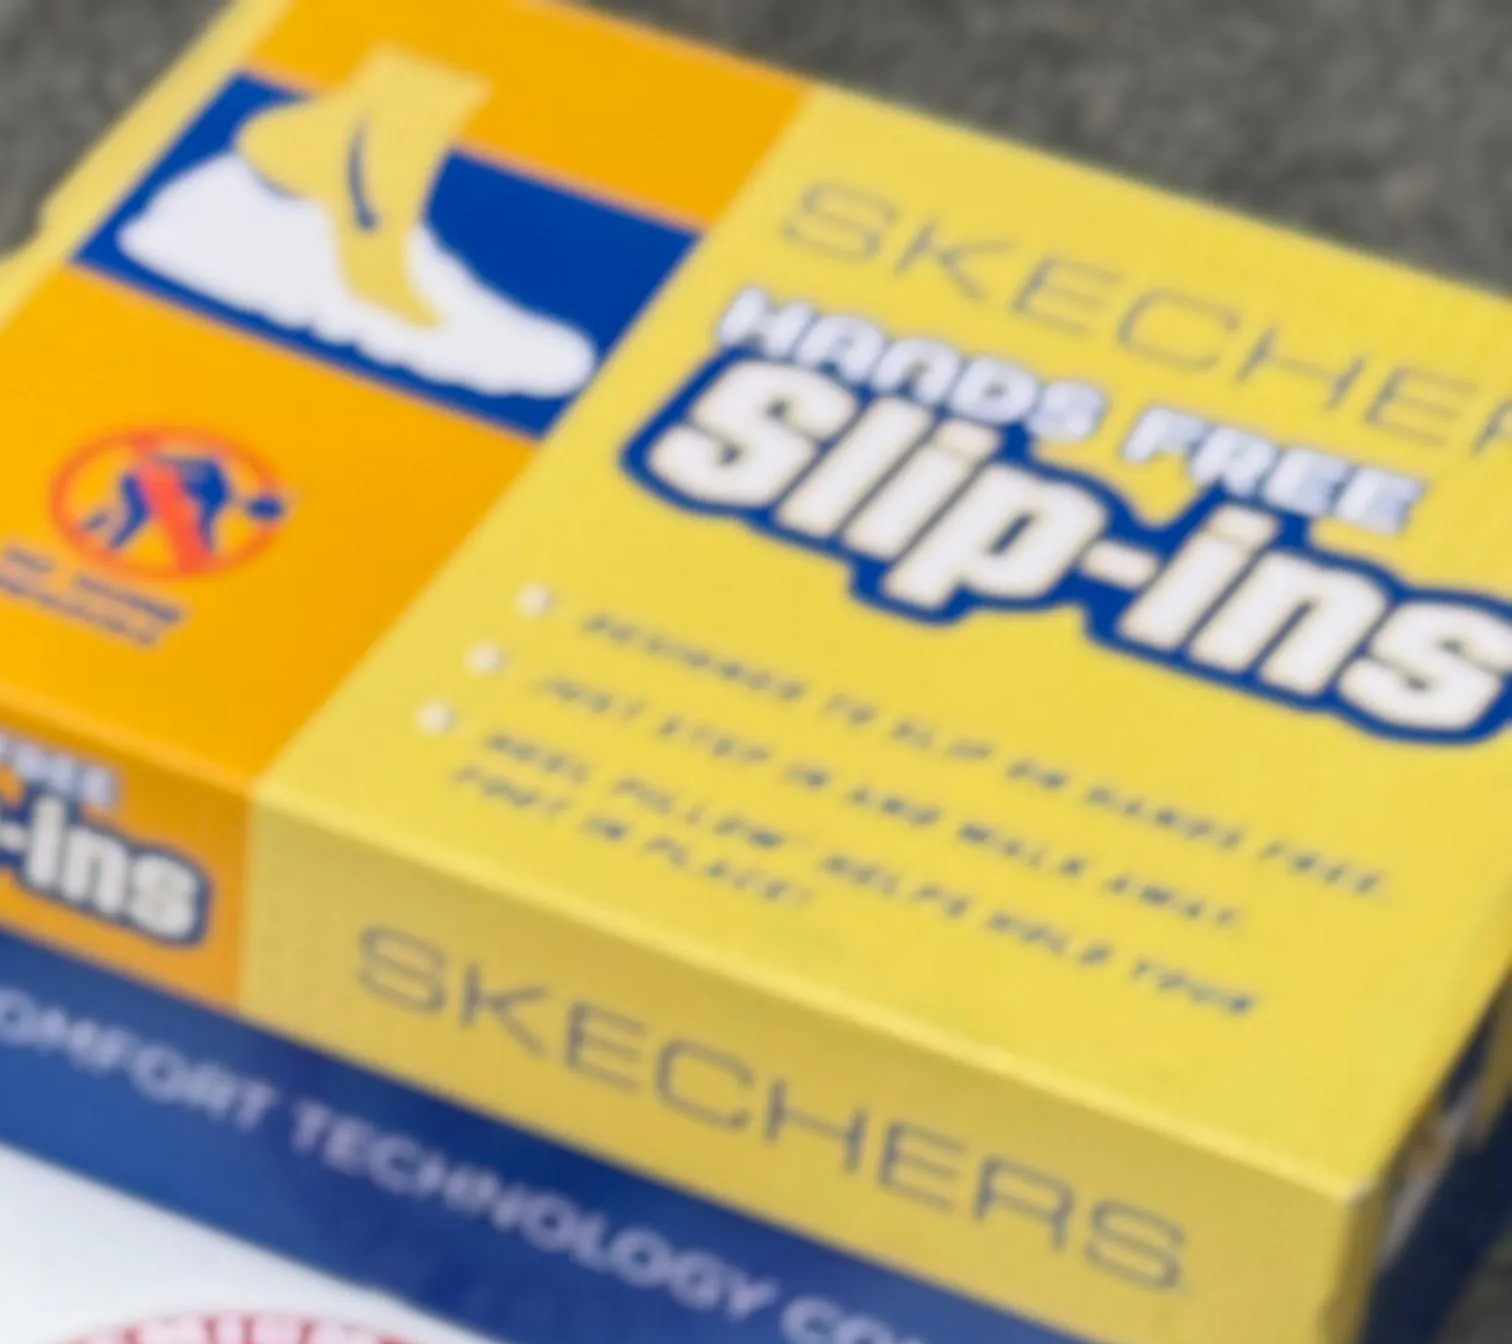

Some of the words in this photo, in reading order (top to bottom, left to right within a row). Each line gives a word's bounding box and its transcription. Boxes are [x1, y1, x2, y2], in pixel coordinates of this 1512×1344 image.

[646, 358, 1512, 734] Slip-ins
[714, 286, 1108, 440] HANDS
[1122, 405, 1426, 536] FREE
[291, 1096, 780, 1320] TECHNOLOGY
[356, 922, 1188, 1296] SKECHERS
